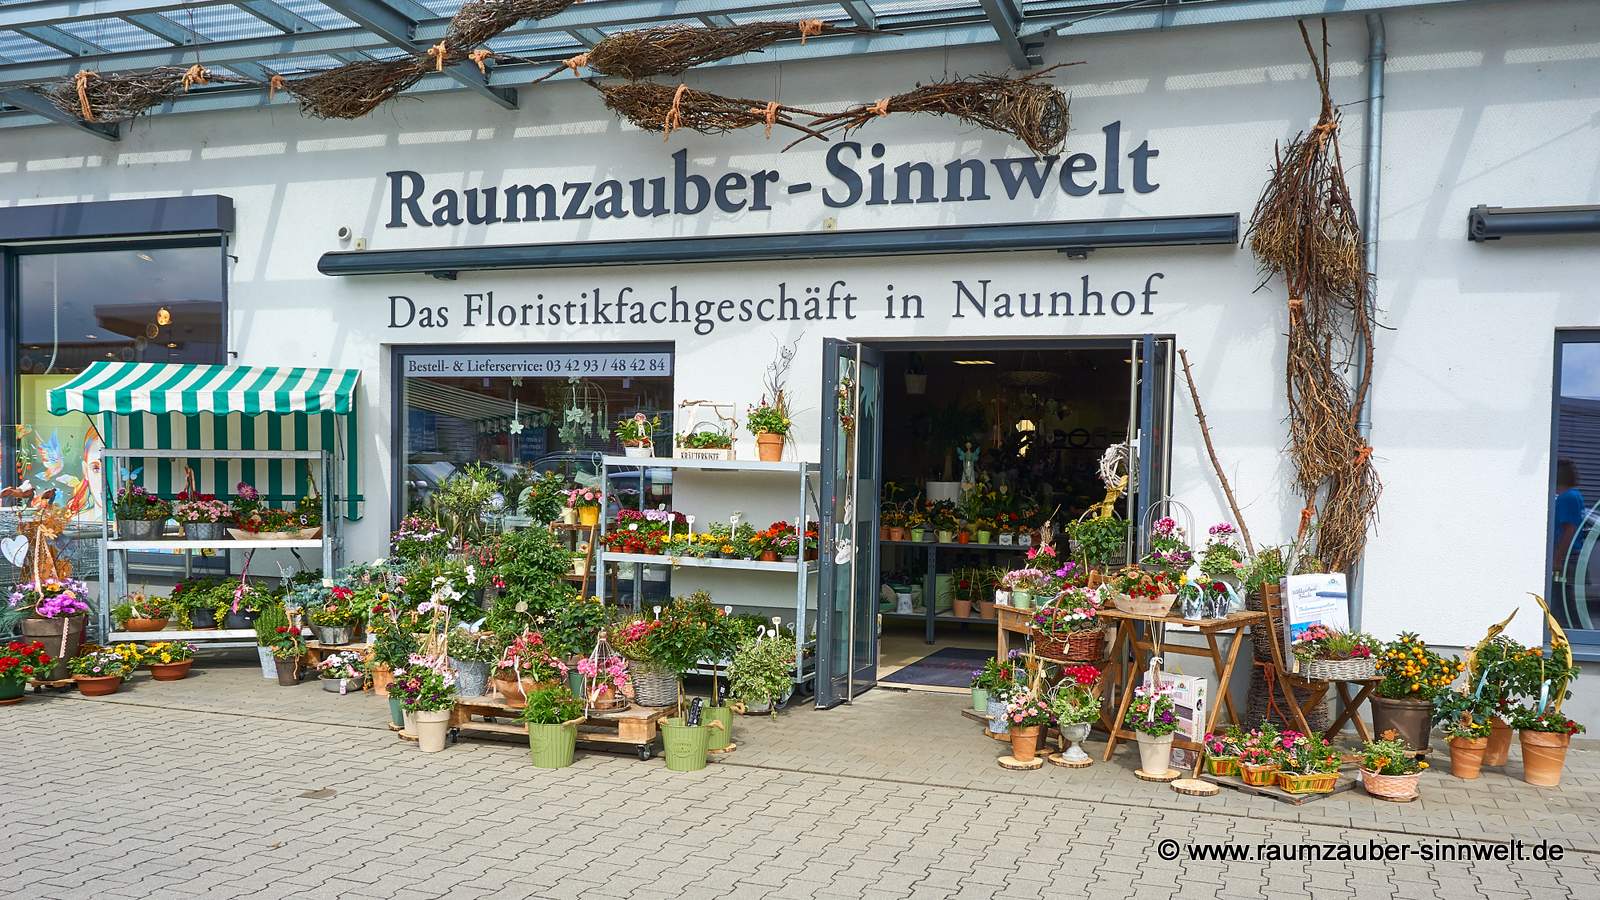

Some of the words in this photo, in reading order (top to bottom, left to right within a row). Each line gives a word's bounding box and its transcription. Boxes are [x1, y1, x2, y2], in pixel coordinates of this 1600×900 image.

[387, 295, 449, 329] Das
[463, 280, 857, 335] Floristikfachgeschäft
[885, 284, 925, 319] in
[952, 272, 1165, 319] Naunhof
[409, 360, 449, 372] Bestell-
[453, 360, 464, 372] &
[468, 359, 543, 372] Lieferservice:
[546, 360, 561, 372] 03
[565, 360, 580, 372] 42
[584, 360, 599, 372] 93
[602, 359, 608, 372] /
[611, 359, 627, 372] 48
[630, 359, 646, 371] 42
[650, 358, 665, 371] 84
